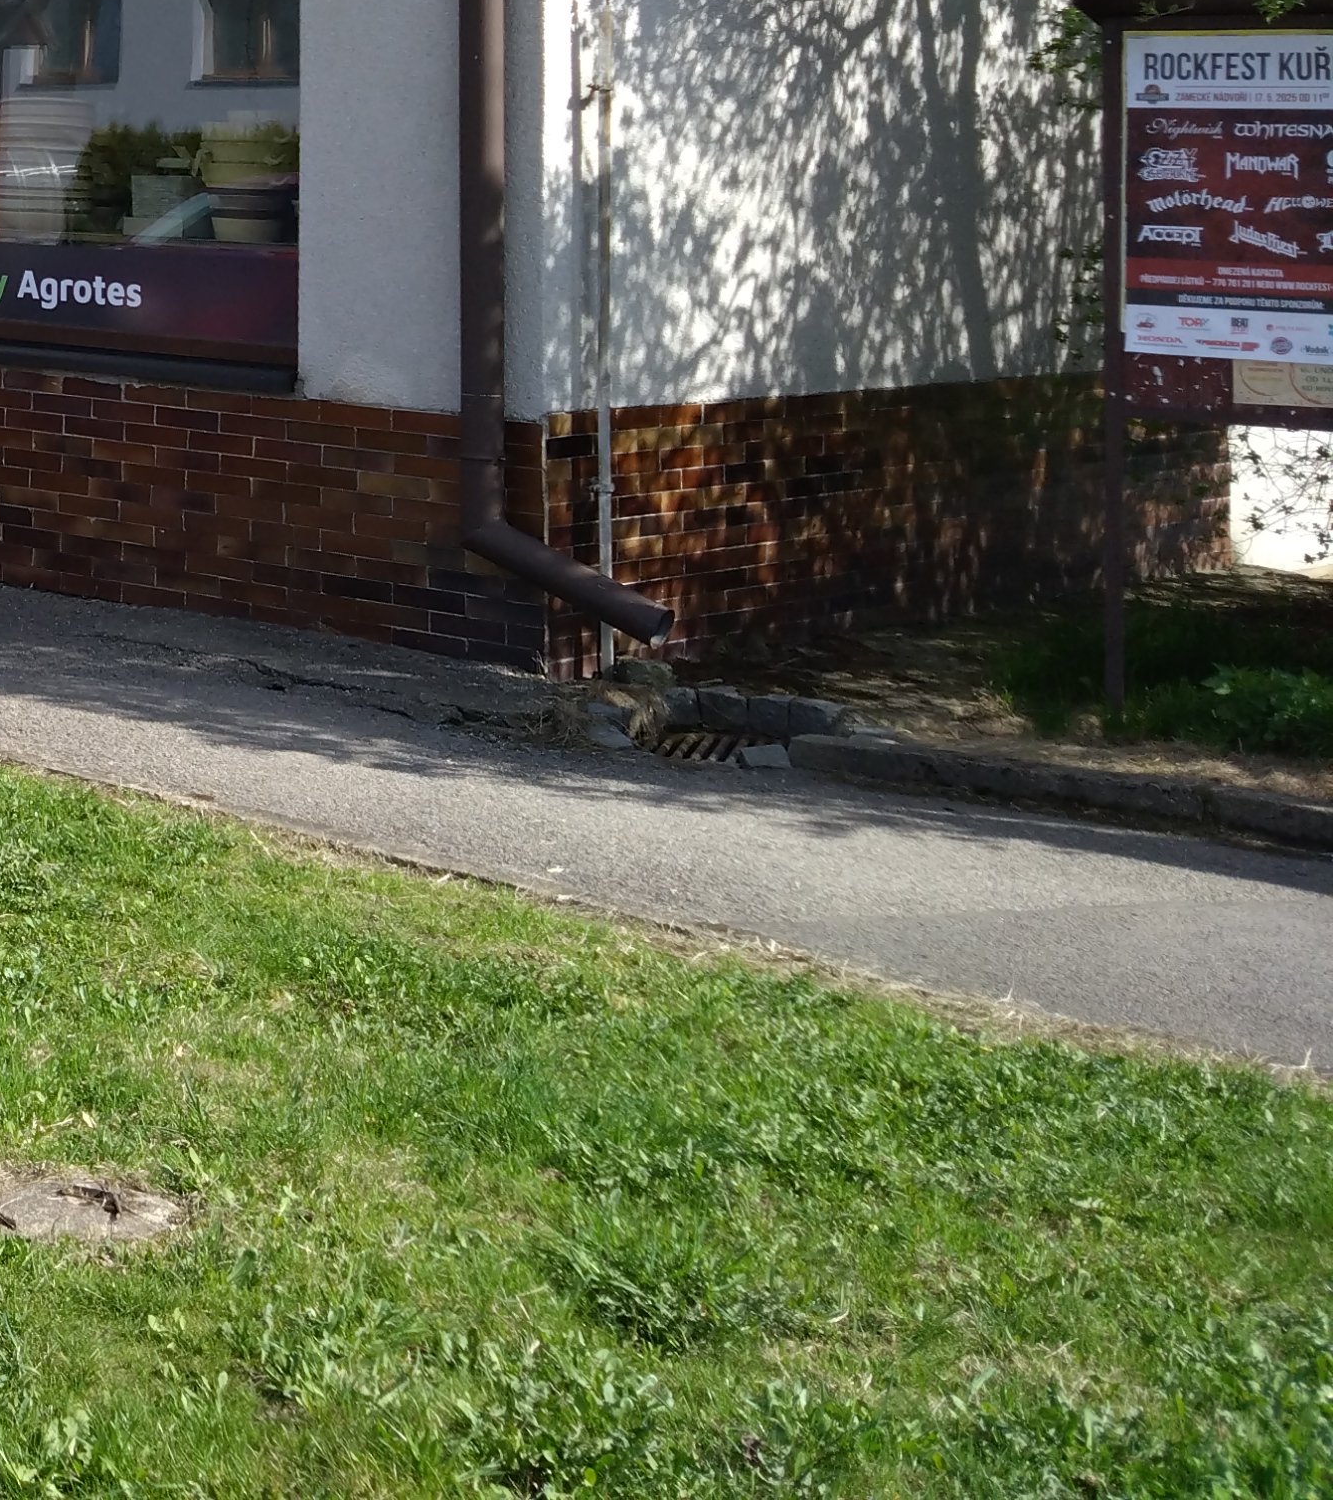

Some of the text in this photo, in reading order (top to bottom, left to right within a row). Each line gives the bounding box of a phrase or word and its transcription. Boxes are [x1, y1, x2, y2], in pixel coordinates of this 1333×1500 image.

[1143, 52, 1271, 81] ROCKFEST
[16, 269, 143, 311] Agrotes
[1137, 334, 1183, 344] HONDA
